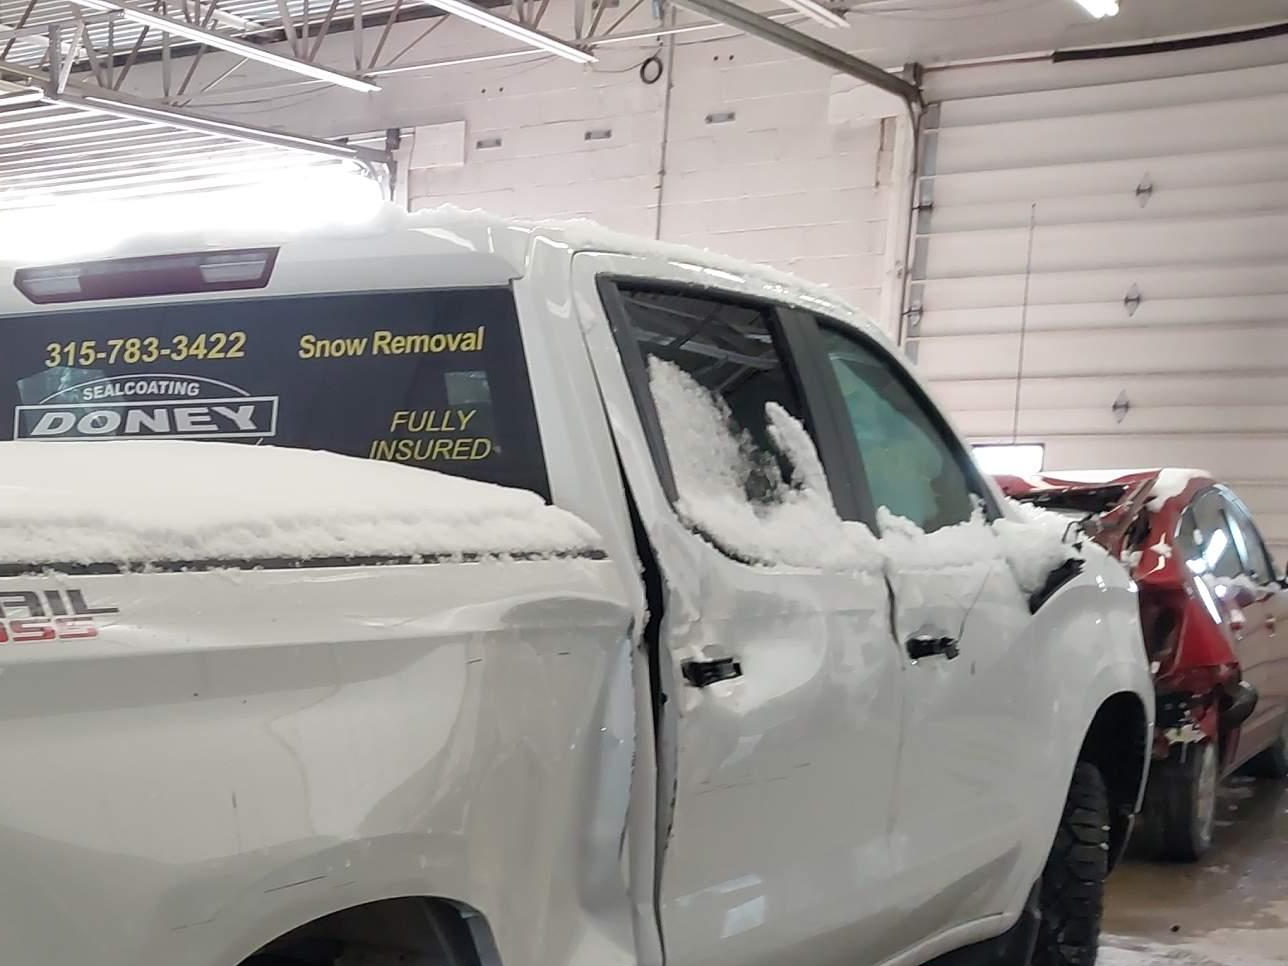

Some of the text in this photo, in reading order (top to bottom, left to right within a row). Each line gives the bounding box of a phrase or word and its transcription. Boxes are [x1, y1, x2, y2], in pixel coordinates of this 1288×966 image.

[44, 331, 247, 368] 315-783-3422
[298, 326, 486, 359] Snow Removal
[82, 380, 201, 402] SEALCOATING
[30, 405, 258, 436] DONEY
[390, 409, 477, 433] FULLY
[368, 437, 492, 461] INSURED
